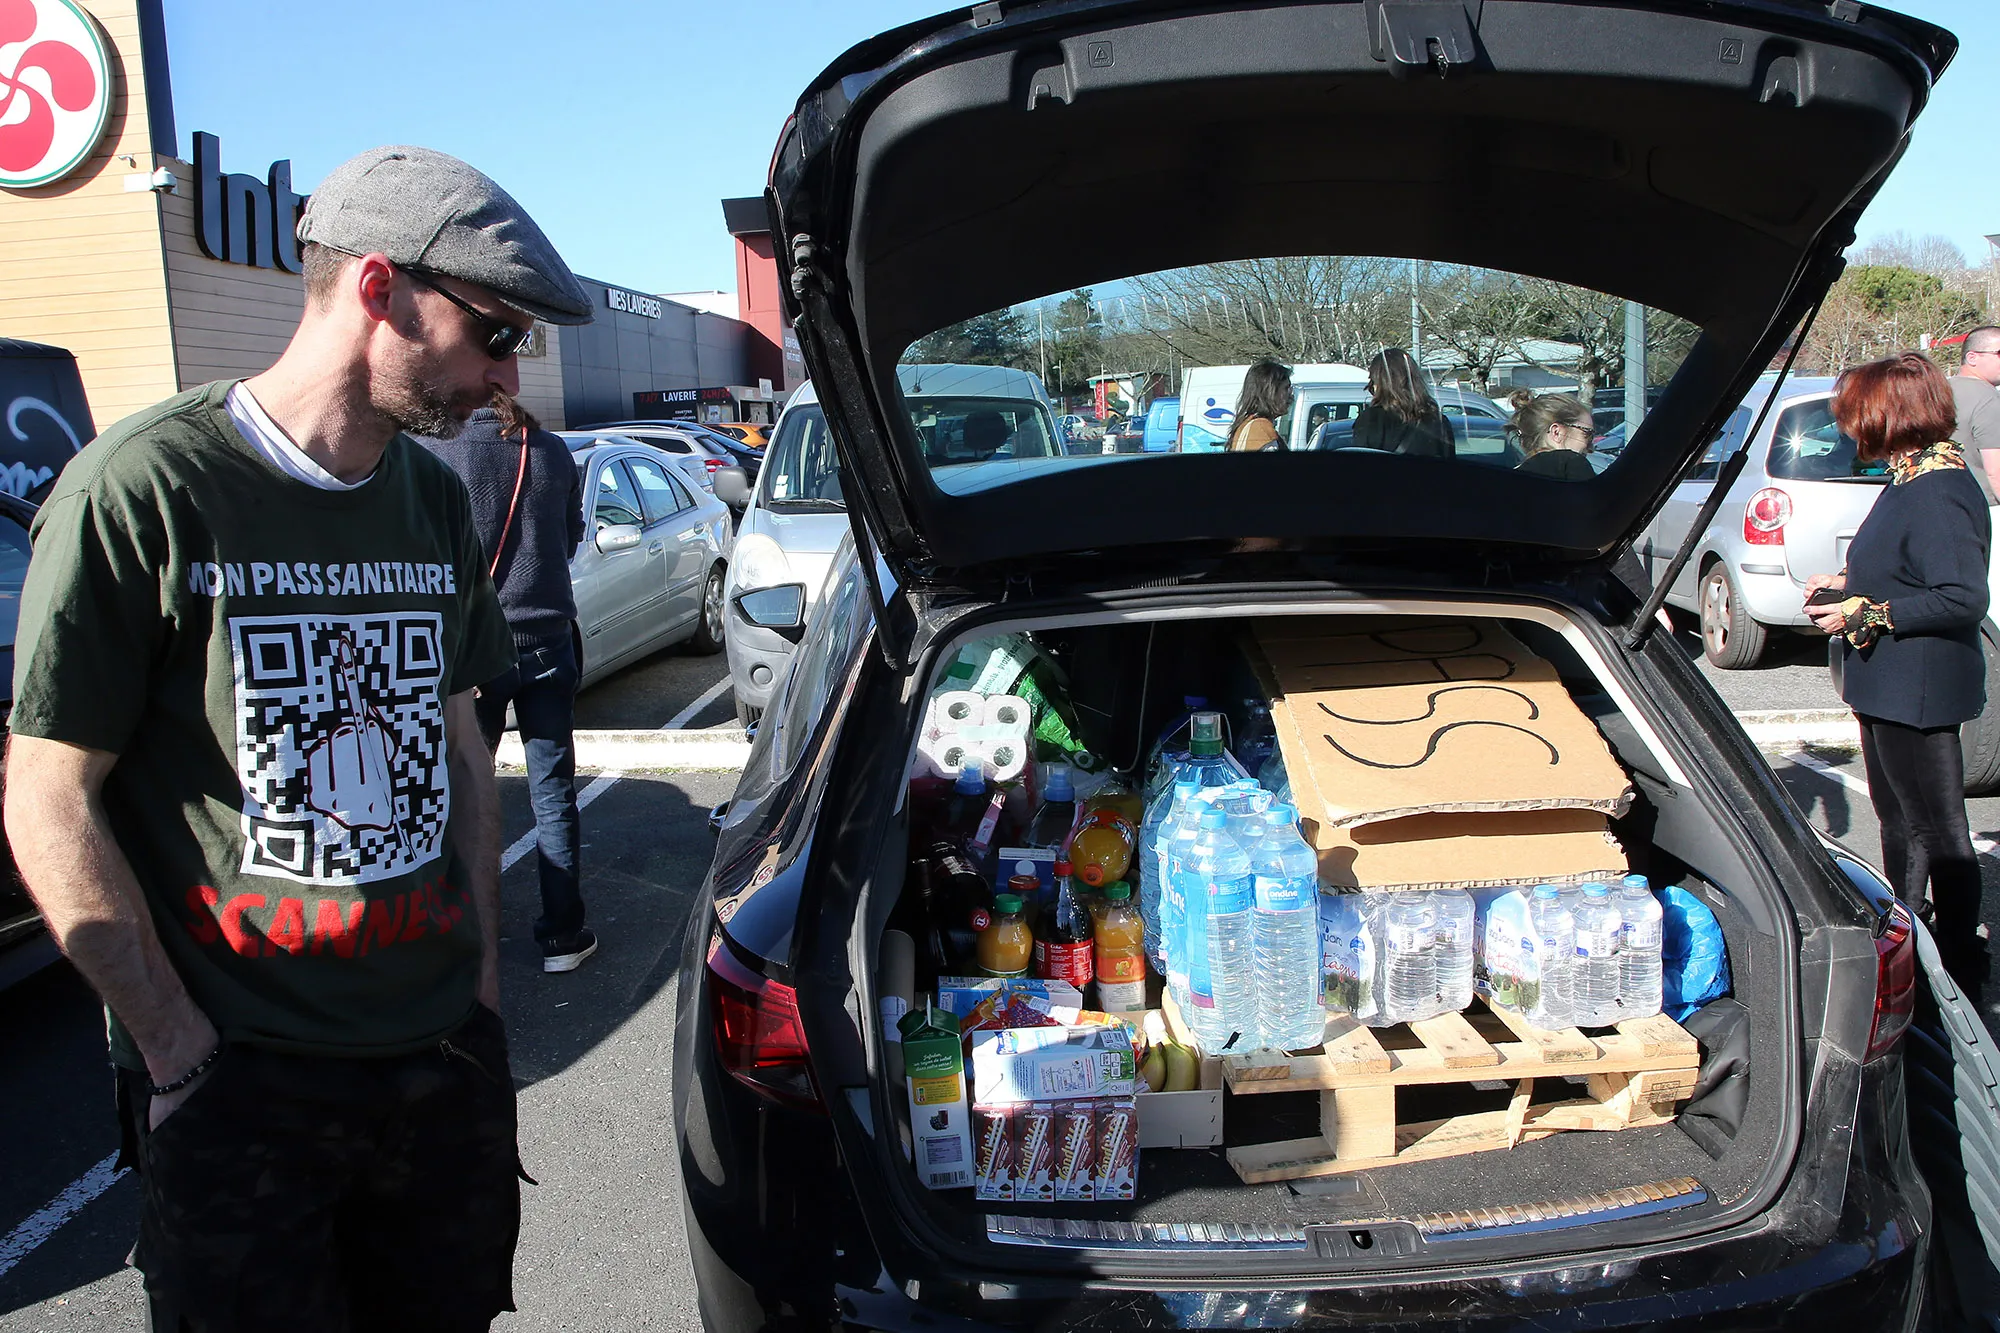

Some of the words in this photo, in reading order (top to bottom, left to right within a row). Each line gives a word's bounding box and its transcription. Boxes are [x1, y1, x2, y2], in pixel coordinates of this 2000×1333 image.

[192, 131, 310, 275] Int
[607, 288, 626, 311] MES
[626, 293, 662, 319] LAVERIES
[662, 390, 697, 402] LAVERIE
[249, 562, 325, 596] PASS
[326, 562, 456, 596] SANITAIRE
[184, 874, 466, 958] SCANNE
